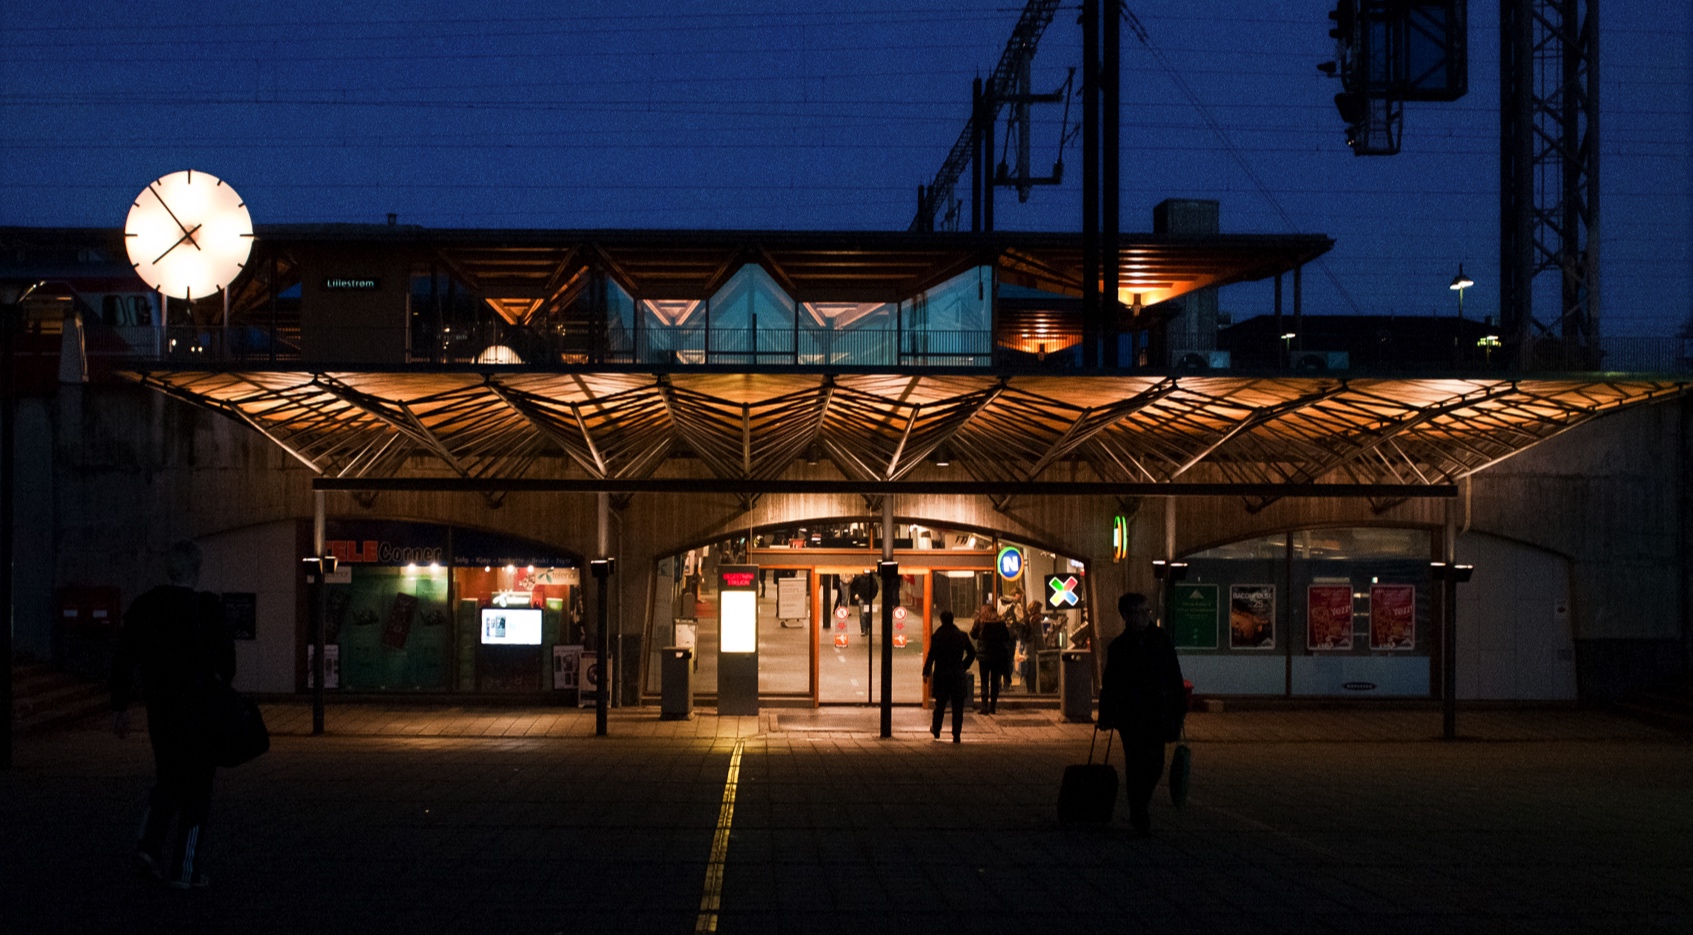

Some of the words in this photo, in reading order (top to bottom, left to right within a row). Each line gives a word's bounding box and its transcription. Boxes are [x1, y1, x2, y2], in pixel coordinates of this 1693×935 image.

[327, 279, 374, 288] Lillestrøm
[379, 541, 442, 562] Corner
[1002, 555, 1019, 573] N
